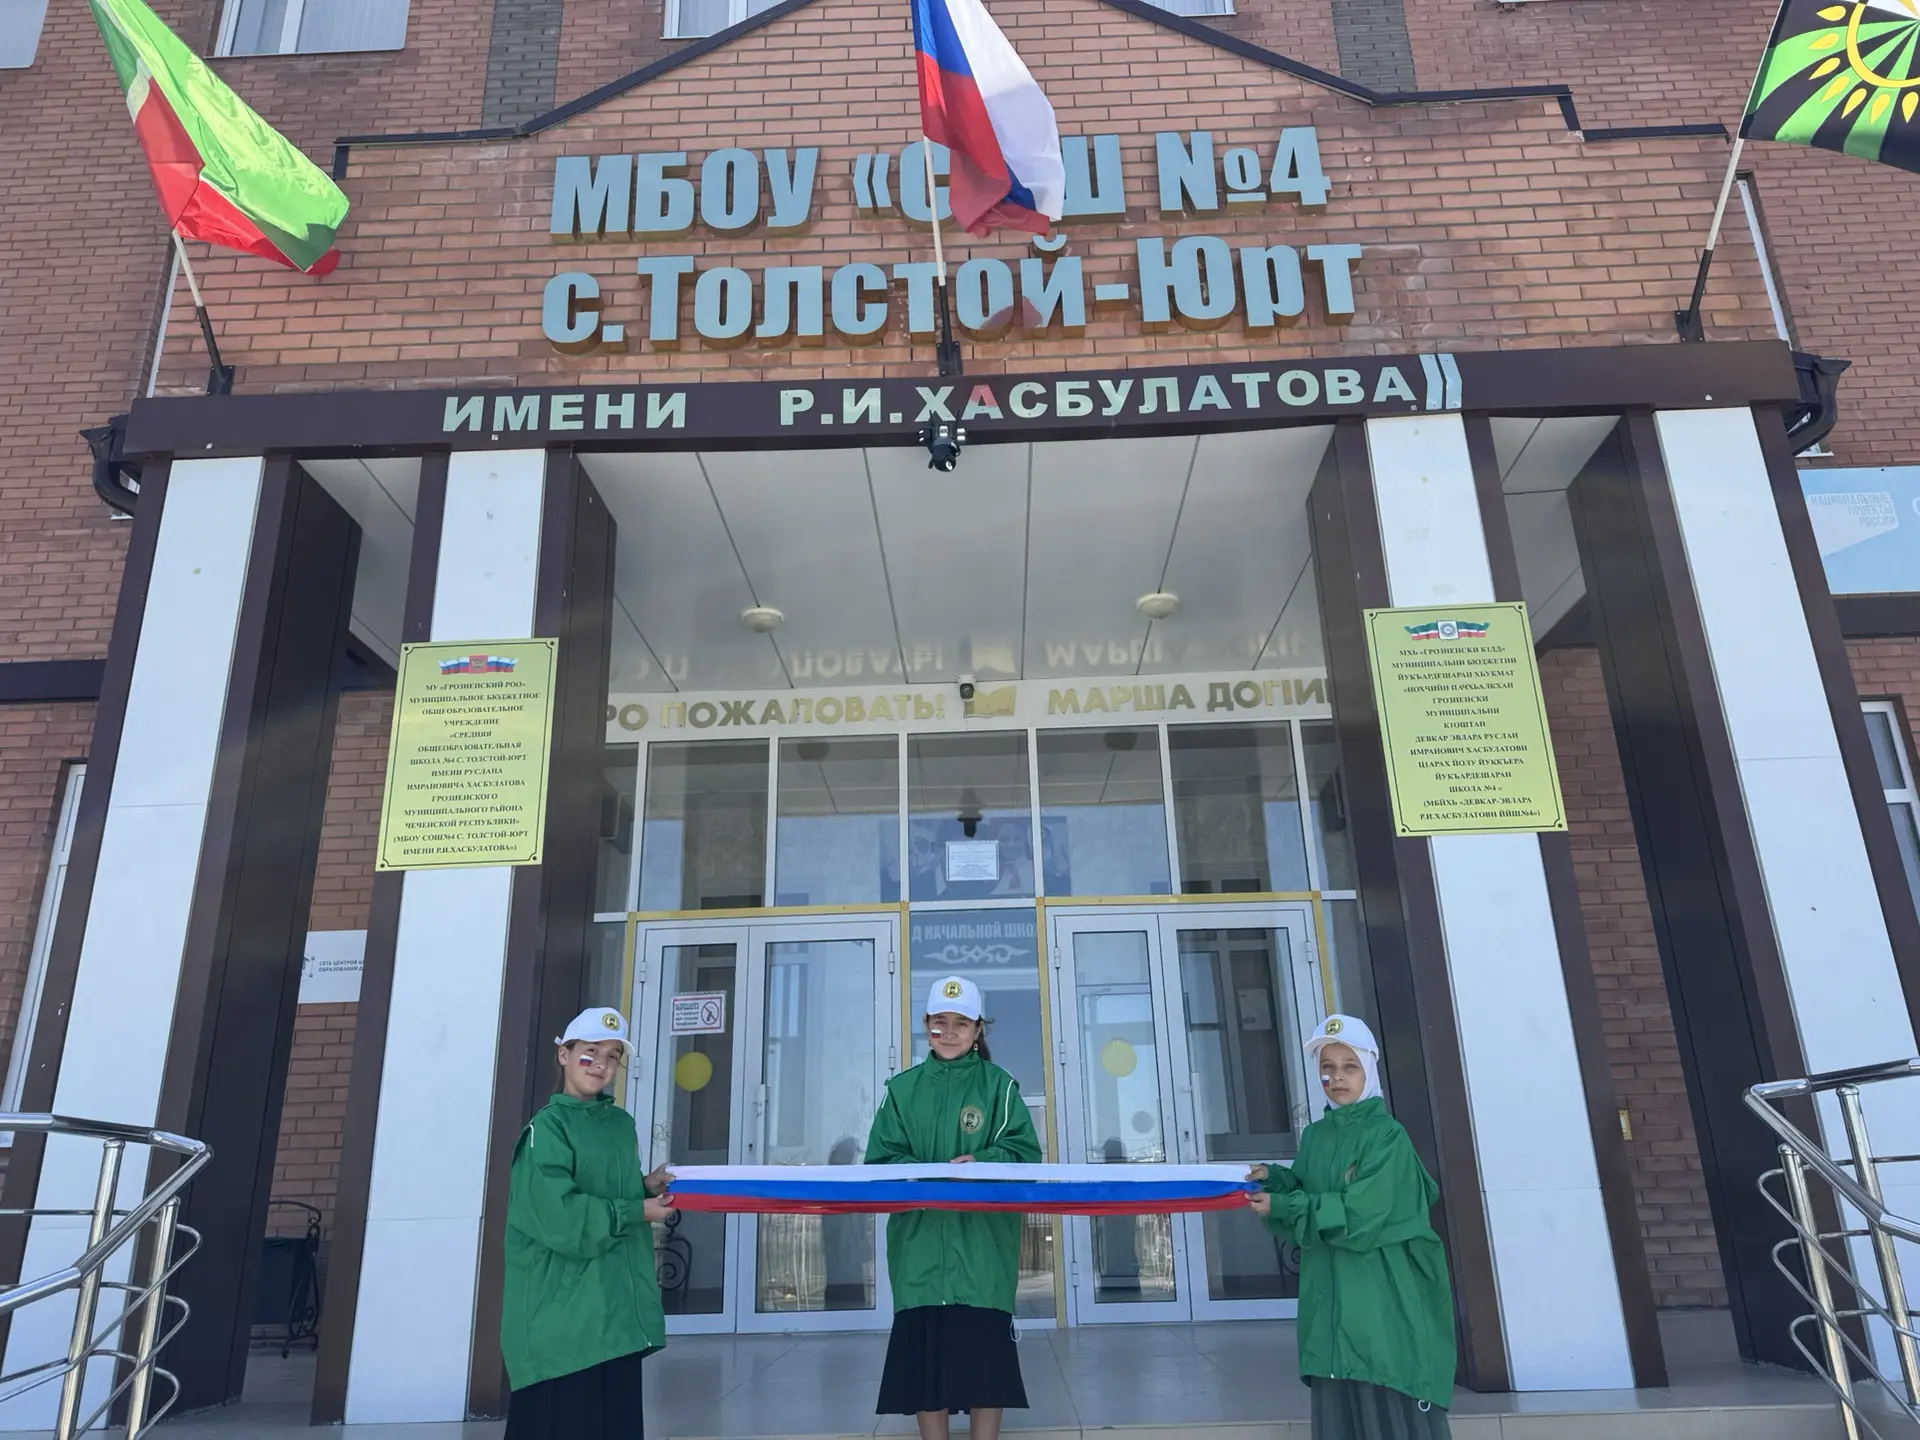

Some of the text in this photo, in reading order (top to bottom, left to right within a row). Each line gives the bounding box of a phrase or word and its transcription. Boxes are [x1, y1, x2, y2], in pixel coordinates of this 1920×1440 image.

[549, 127, 1332, 236] МБОУ «СШ №4
[442, 391, 687, 432] ИМЕНИ
[1809, 493, 1892, 506] НАЦИОНАЛЬНЫЕ
[1847, 504, 1895, 516] ПРОЕКТЫ
[1859, 515, 1897, 527] РОССИИ
[440, 680, 503, 690] «ГРОЗНЕНСКИЙ
[409, 692, 540, 704] МУНИЦИПАЛЬНОЕ БЮДЖЕТНОЕ
[421, 705, 525, 716] ОБЩЕОБРАЗОВАТЕЛЬНОЕ
[660, 693, 946, 729] ПОЖАЛОВАТЬ!
[1047, 683, 1195, 715] МАРША
[444, 718, 500, 726] УЧРЕЖДЕНИЕ
[449, 730, 492, 739] «СРЕДНЯЯ
[1415, 735, 1449, 743] ДЕВКАР
[1484, 732, 1519, 740] РУСЛАН
[417, 741, 522, 752] ОБЩЕОБРАЗОВАТЕЛЬНАЯ
[1410, 747, 1464, 756] ИМРАНОВИЧ
[466, 753, 528, 763] ТОЛСТОЙ-ЮРТ
[431, 767, 503, 777] ИМЕНИ РУСЛАНА
[406, 779, 526, 790] ИМРАНОВИЧА ХАСБУЛАТОВА
[1449, 785, 1482, 793] ШКОЛА
[431, 793, 498, 802] ГРОЗНЕНСКОГО
[403, 804, 523, 816] МУНИЦИПАЛЬНОГО РАЙОНА
[405, 817, 520, 829] ЧЕЧЕНСКОЙ РЕСПУБЛИКИ»
[393, 834, 420, 843] (МБОУ
[467, 830, 529, 840] ТОЛСТОЙ-ЮРТ
[403, 847, 435, 855] ИМЕНИ
[924, 921, 1001, 941] НАЧАЛЬНОЙ
